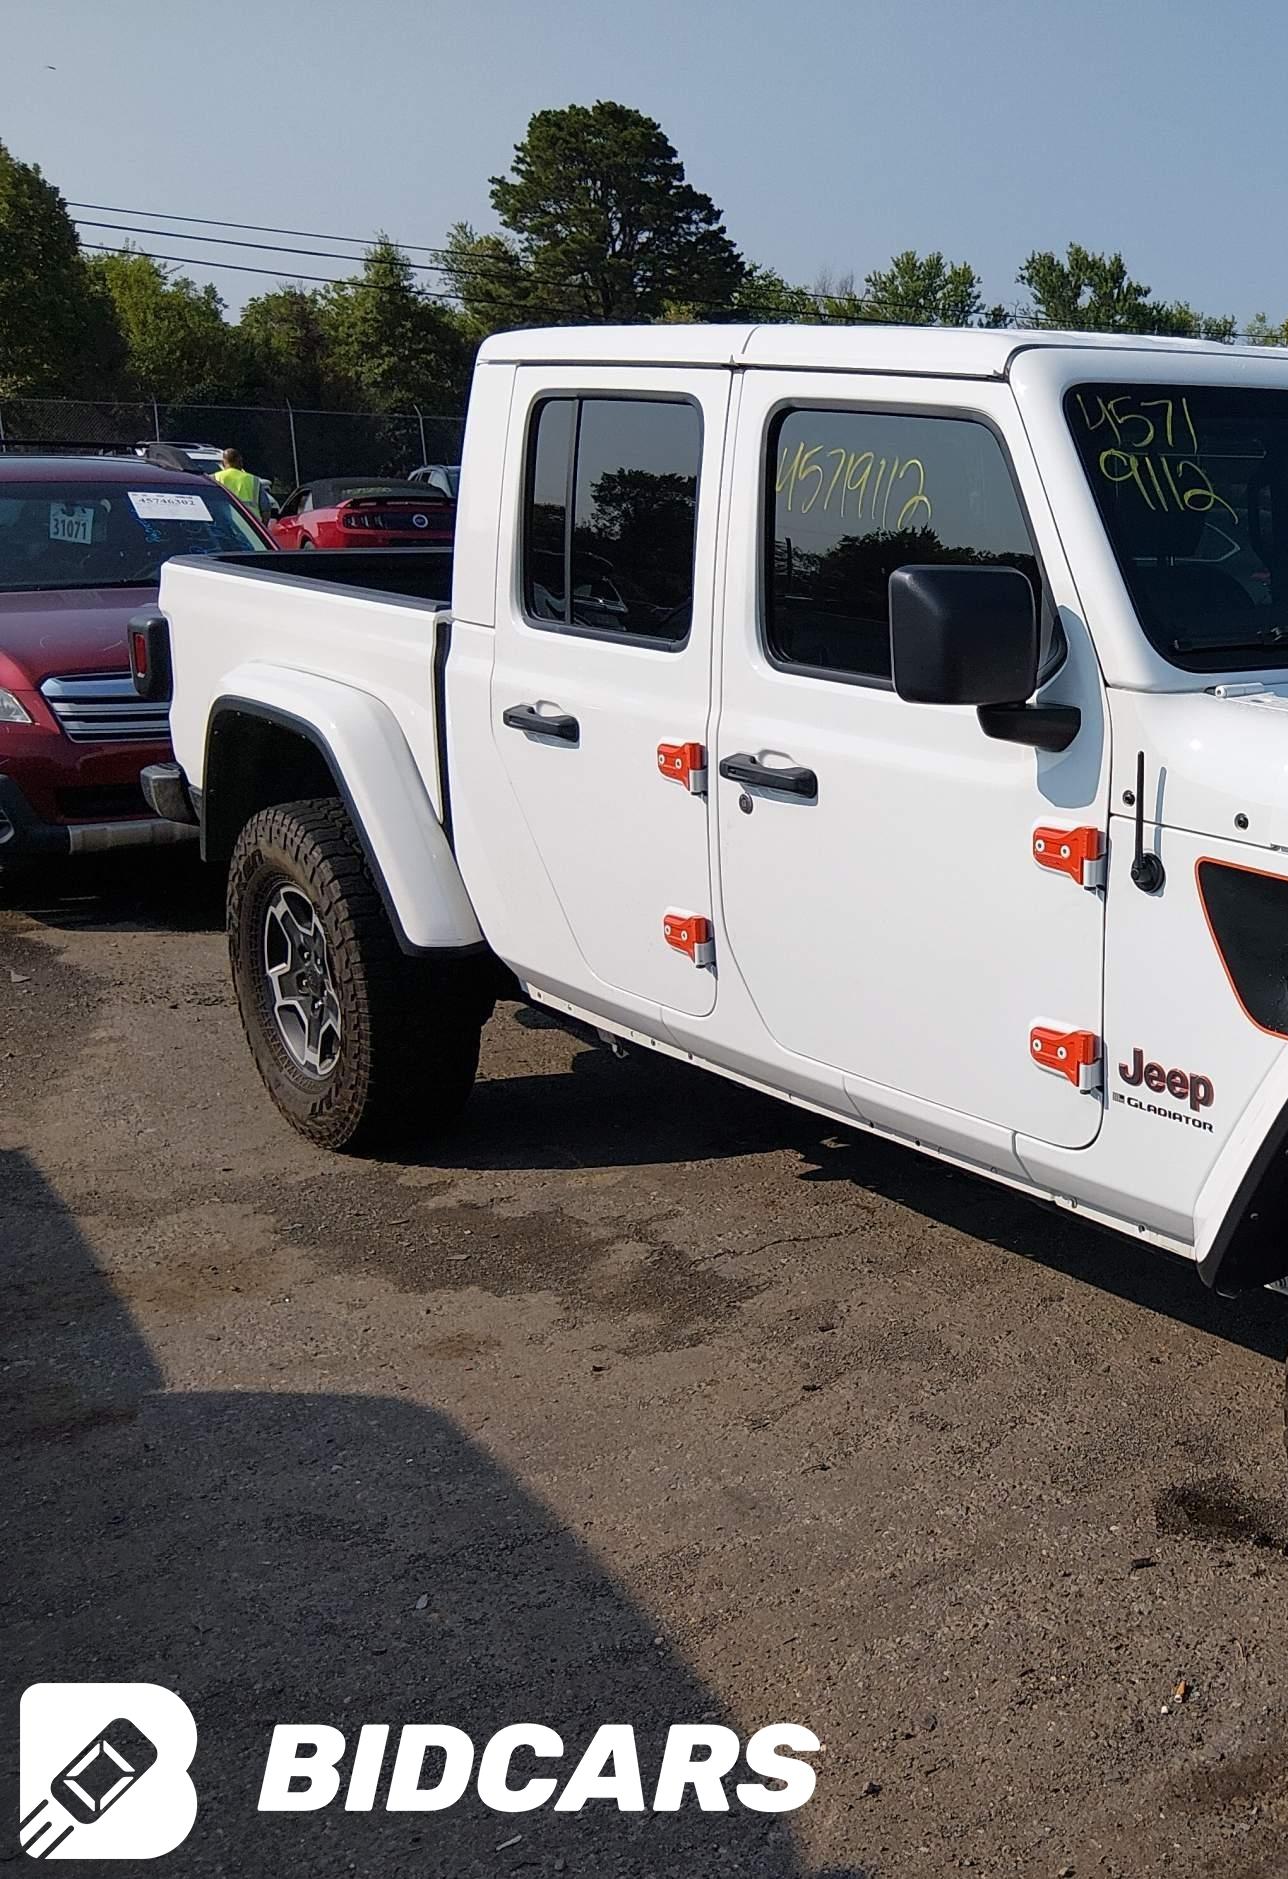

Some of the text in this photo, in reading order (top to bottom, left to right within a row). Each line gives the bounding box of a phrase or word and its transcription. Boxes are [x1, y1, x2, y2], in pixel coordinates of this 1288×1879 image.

[1076, 394, 1198, 456] 4571
[775, 441, 933, 530] 45719112
[1100, 449, 1239, 525] 9112
[53, 518, 87, 541] 31071
[1118, 1047, 1215, 1113] Jeep
[1127, 1096, 1214, 1134] GLADIATOR
